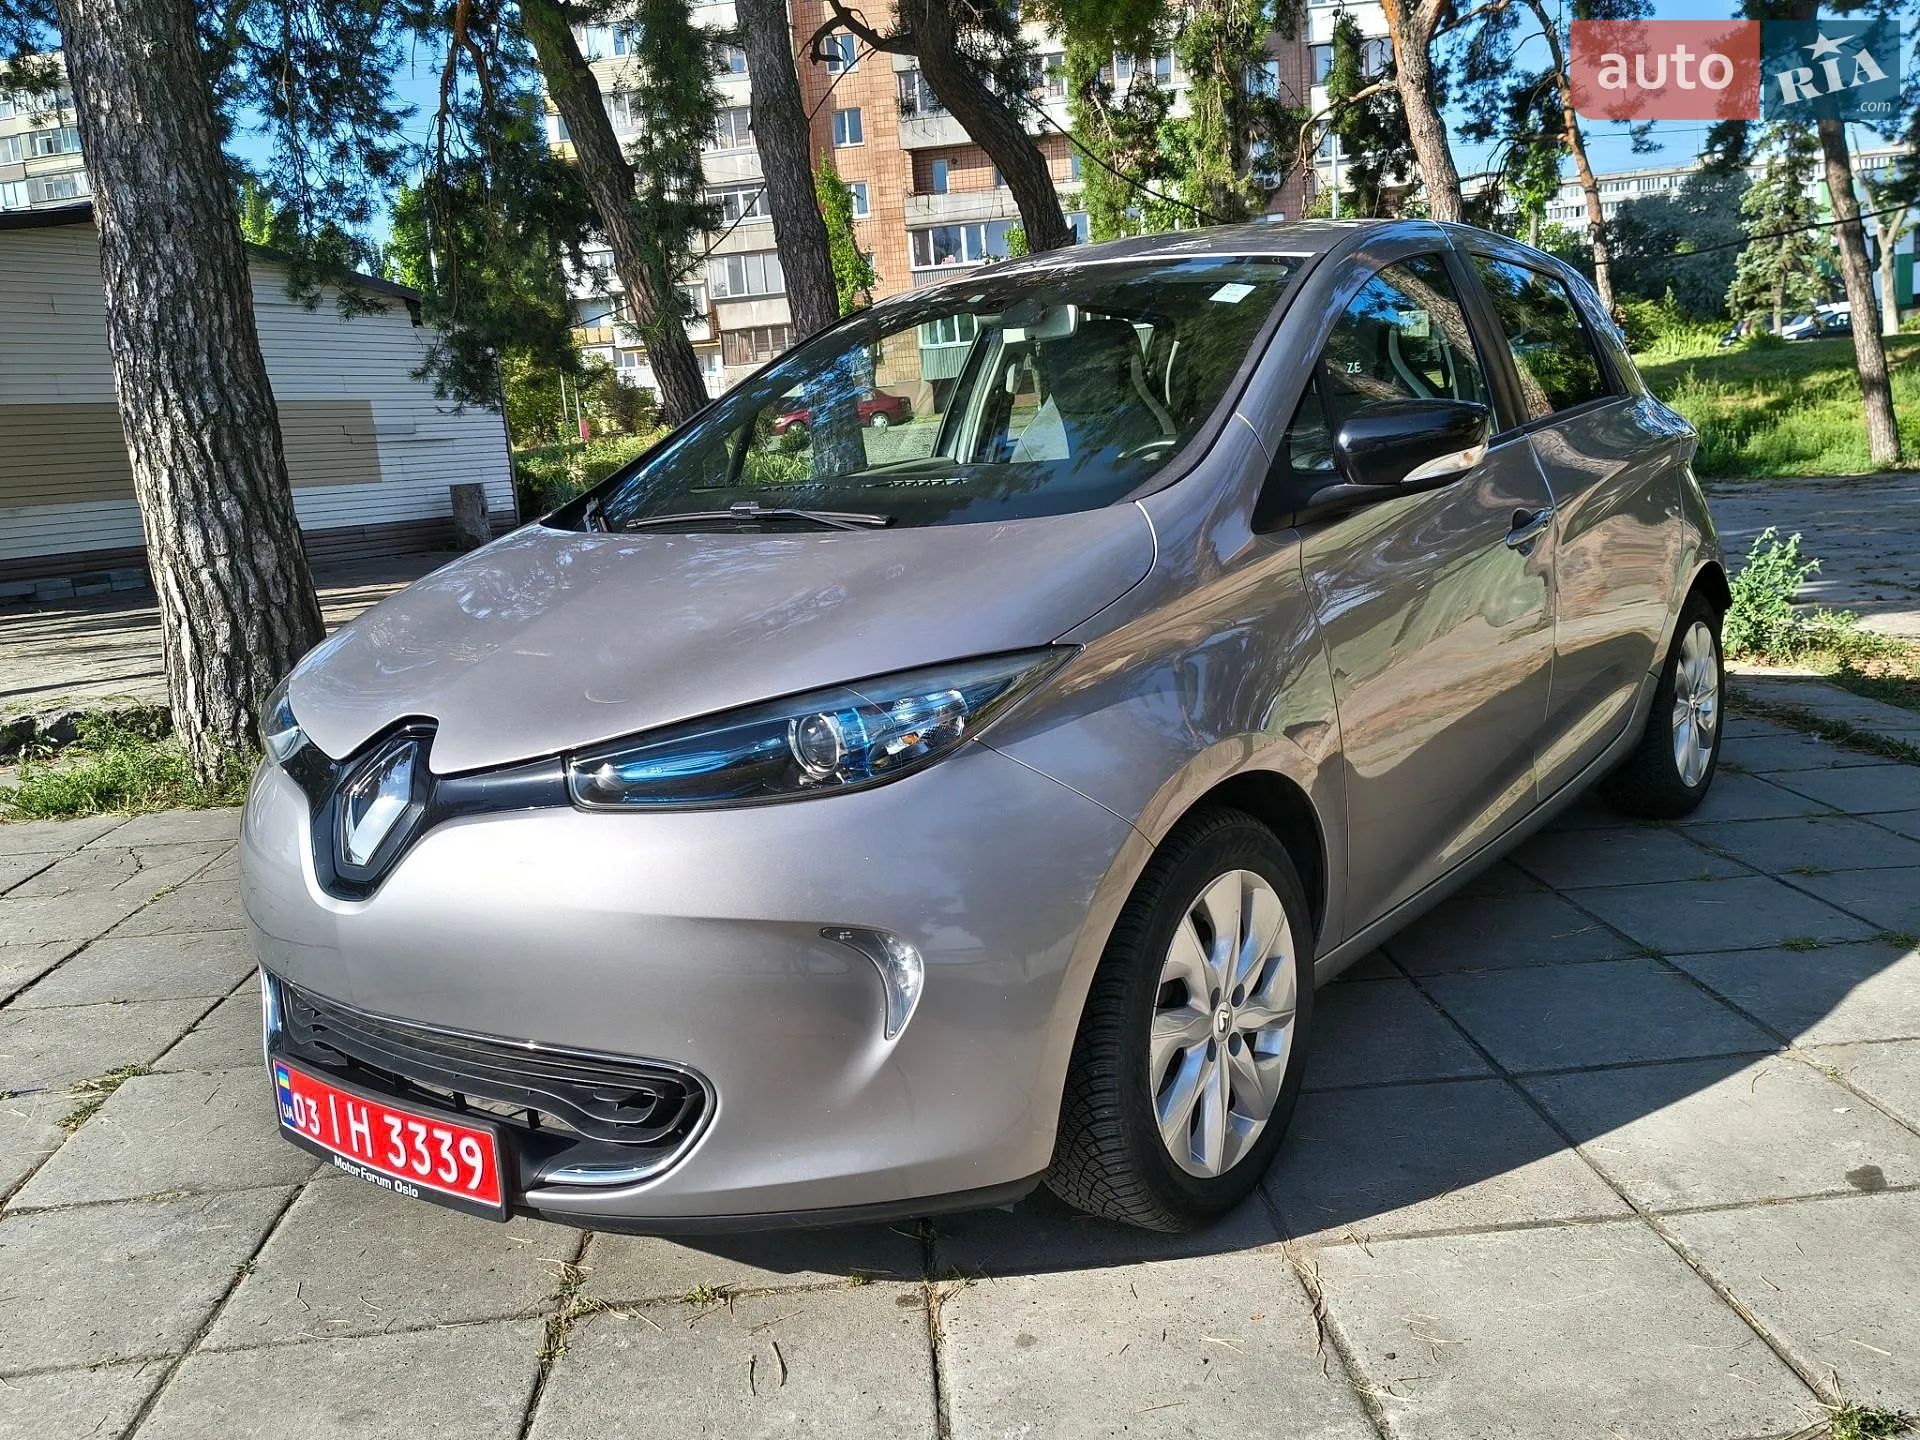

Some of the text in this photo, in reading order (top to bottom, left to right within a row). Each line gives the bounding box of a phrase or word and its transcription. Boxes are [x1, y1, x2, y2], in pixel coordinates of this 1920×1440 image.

[282, 1102, 295, 1122] UA
[293, 1092, 320, 1136] 03
[384, 1114, 483, 1190] 3339
[395, 1180, 419, 1198] Oslo
